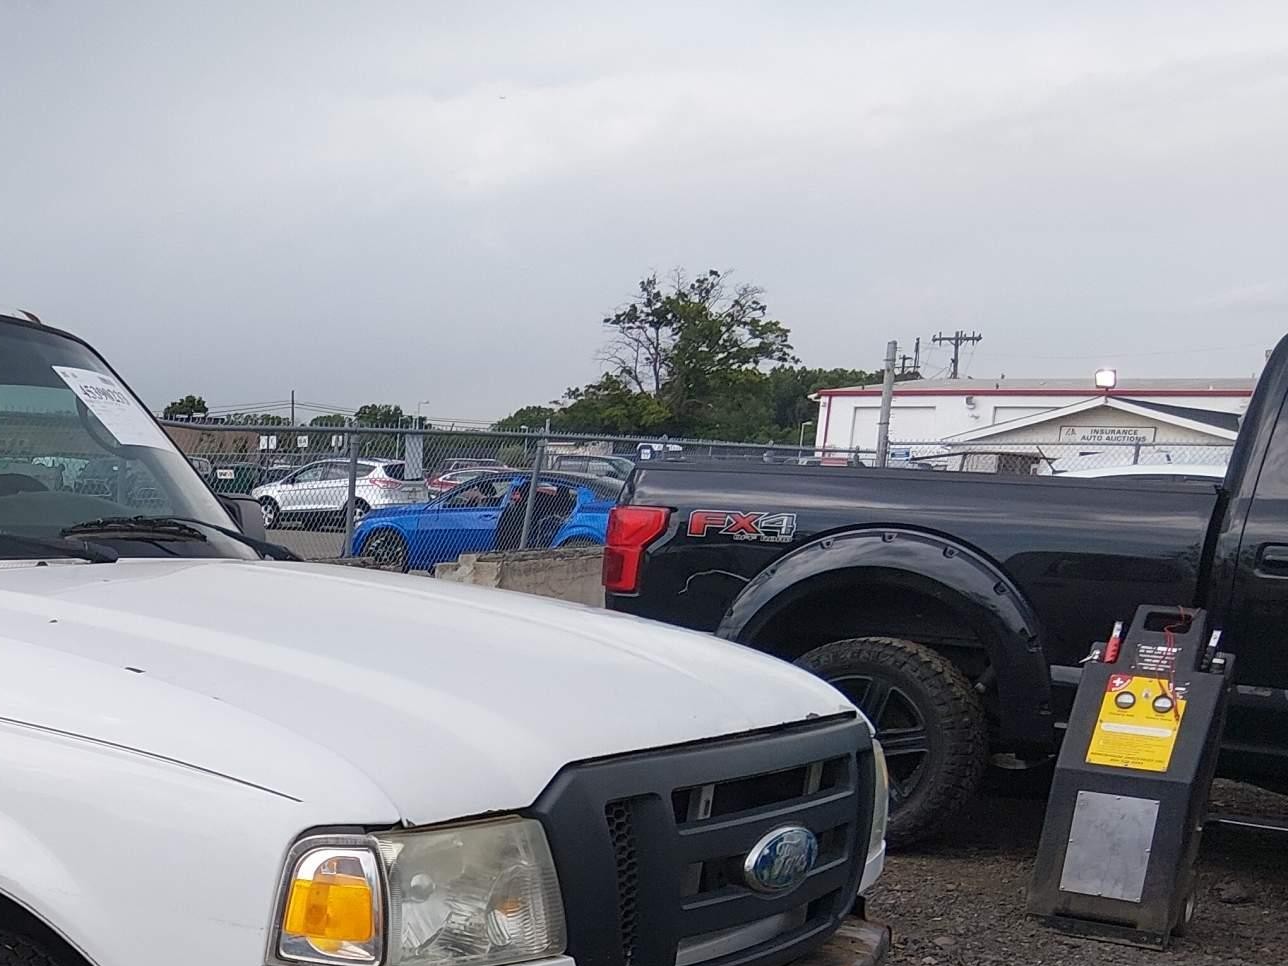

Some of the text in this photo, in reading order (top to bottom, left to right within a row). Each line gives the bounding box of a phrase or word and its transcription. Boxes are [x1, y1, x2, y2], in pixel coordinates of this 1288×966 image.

[1090, 428, 1139, 436] INSURANCE
[1105, 435, 1146, 443] AUCTIONS
[687, 509, 797, 537] FX4
